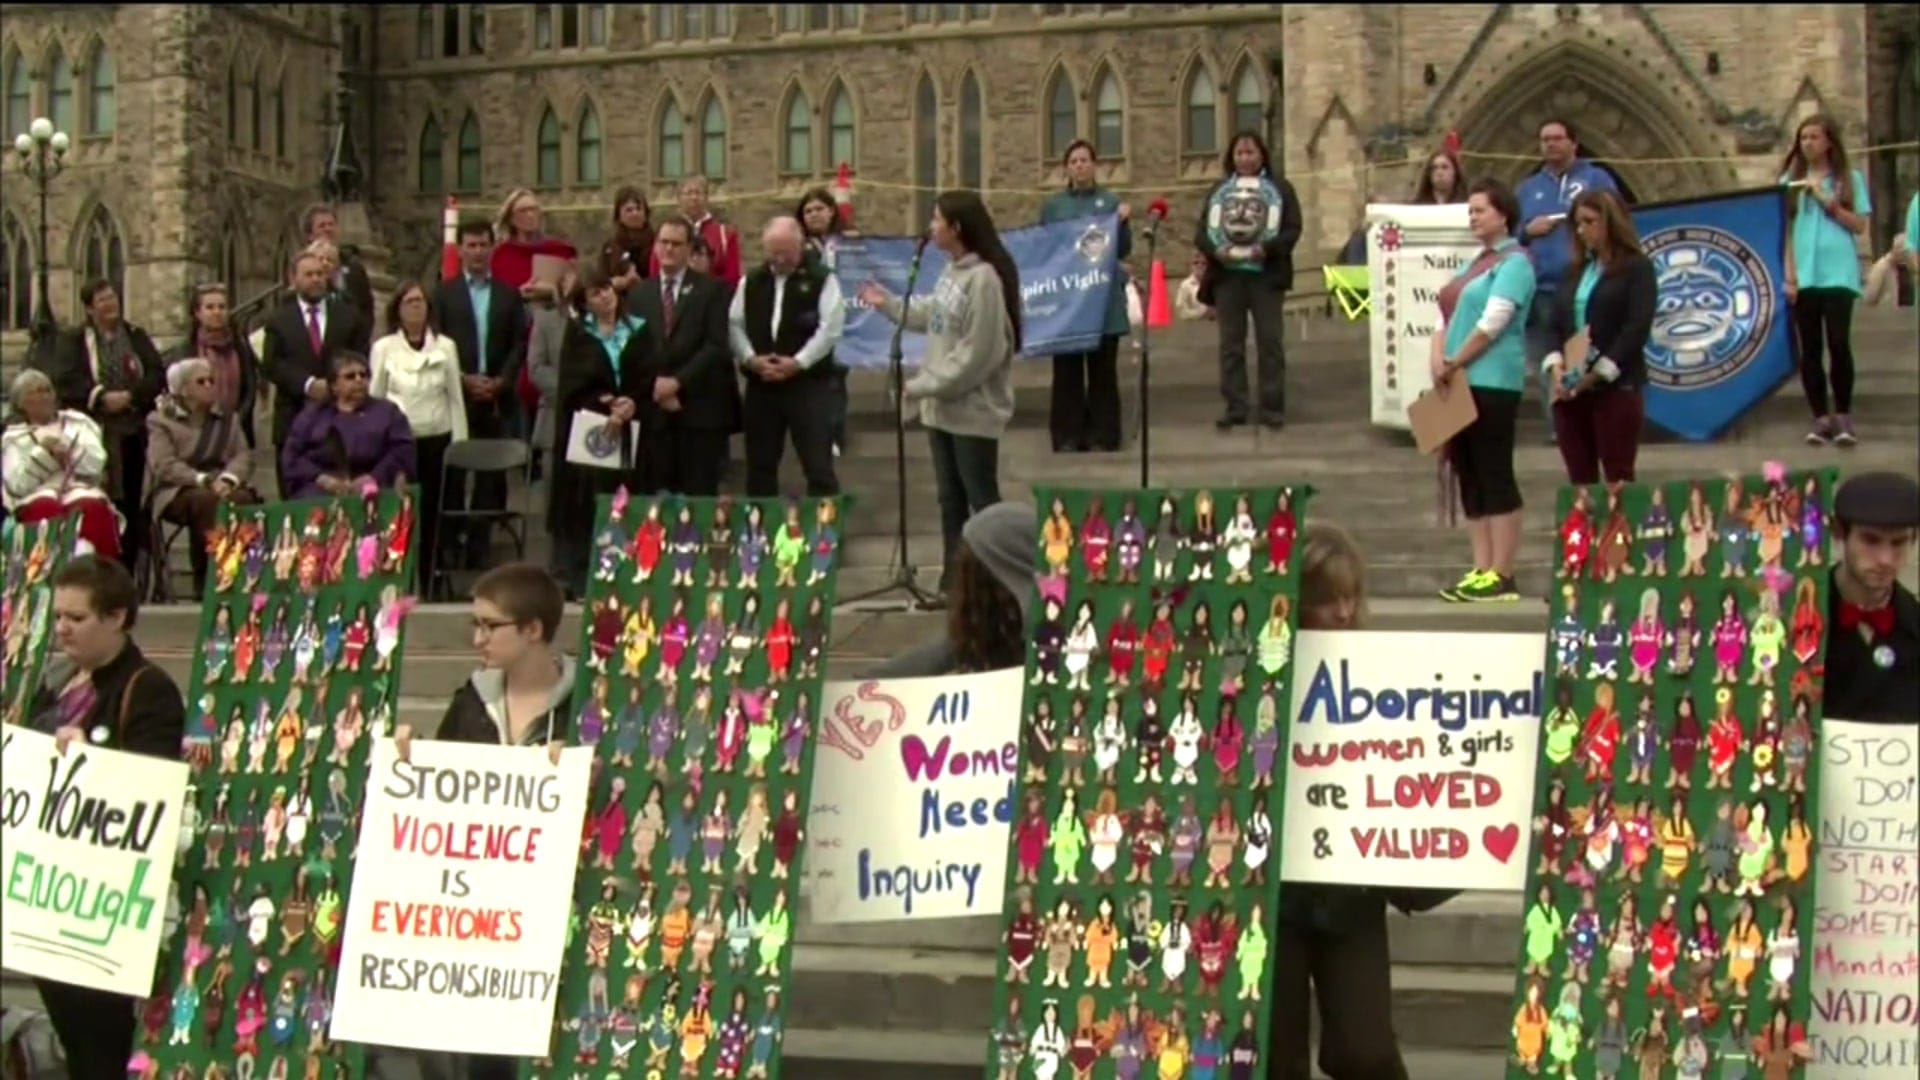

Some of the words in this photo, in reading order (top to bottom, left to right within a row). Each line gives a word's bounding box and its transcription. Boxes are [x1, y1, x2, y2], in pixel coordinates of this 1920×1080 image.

[927, 690, 969, 725] All
[1297, 658, 1543, 731] Aboriginal
[818, 680, 906, 761] YES
[1292, 736, 1425, 768] women
[1437, 731, 1454, 757] &
[1460, 729, 1514, 767] girls
[1827, 733, 1911, 768] STO
[384, 758, 561, 813] STOPPING
[1306, 783, 1349, 810] are
[1366, 770, 1502, 809] LOVED
[919, 779, 1017, 839] Need
[393, 812, 542, 862] VIOLENCE
[1313, 827, 1333, 859] &
[1350, 826, 1469, 860] VALUED
[441, 869, 470, 897] IS
[858, 848, 981, 914] Inquiry
[360, 953, 555, 1002] RESPONSIBILITY
[1808, 1034, 1918, 1068] INQUI
